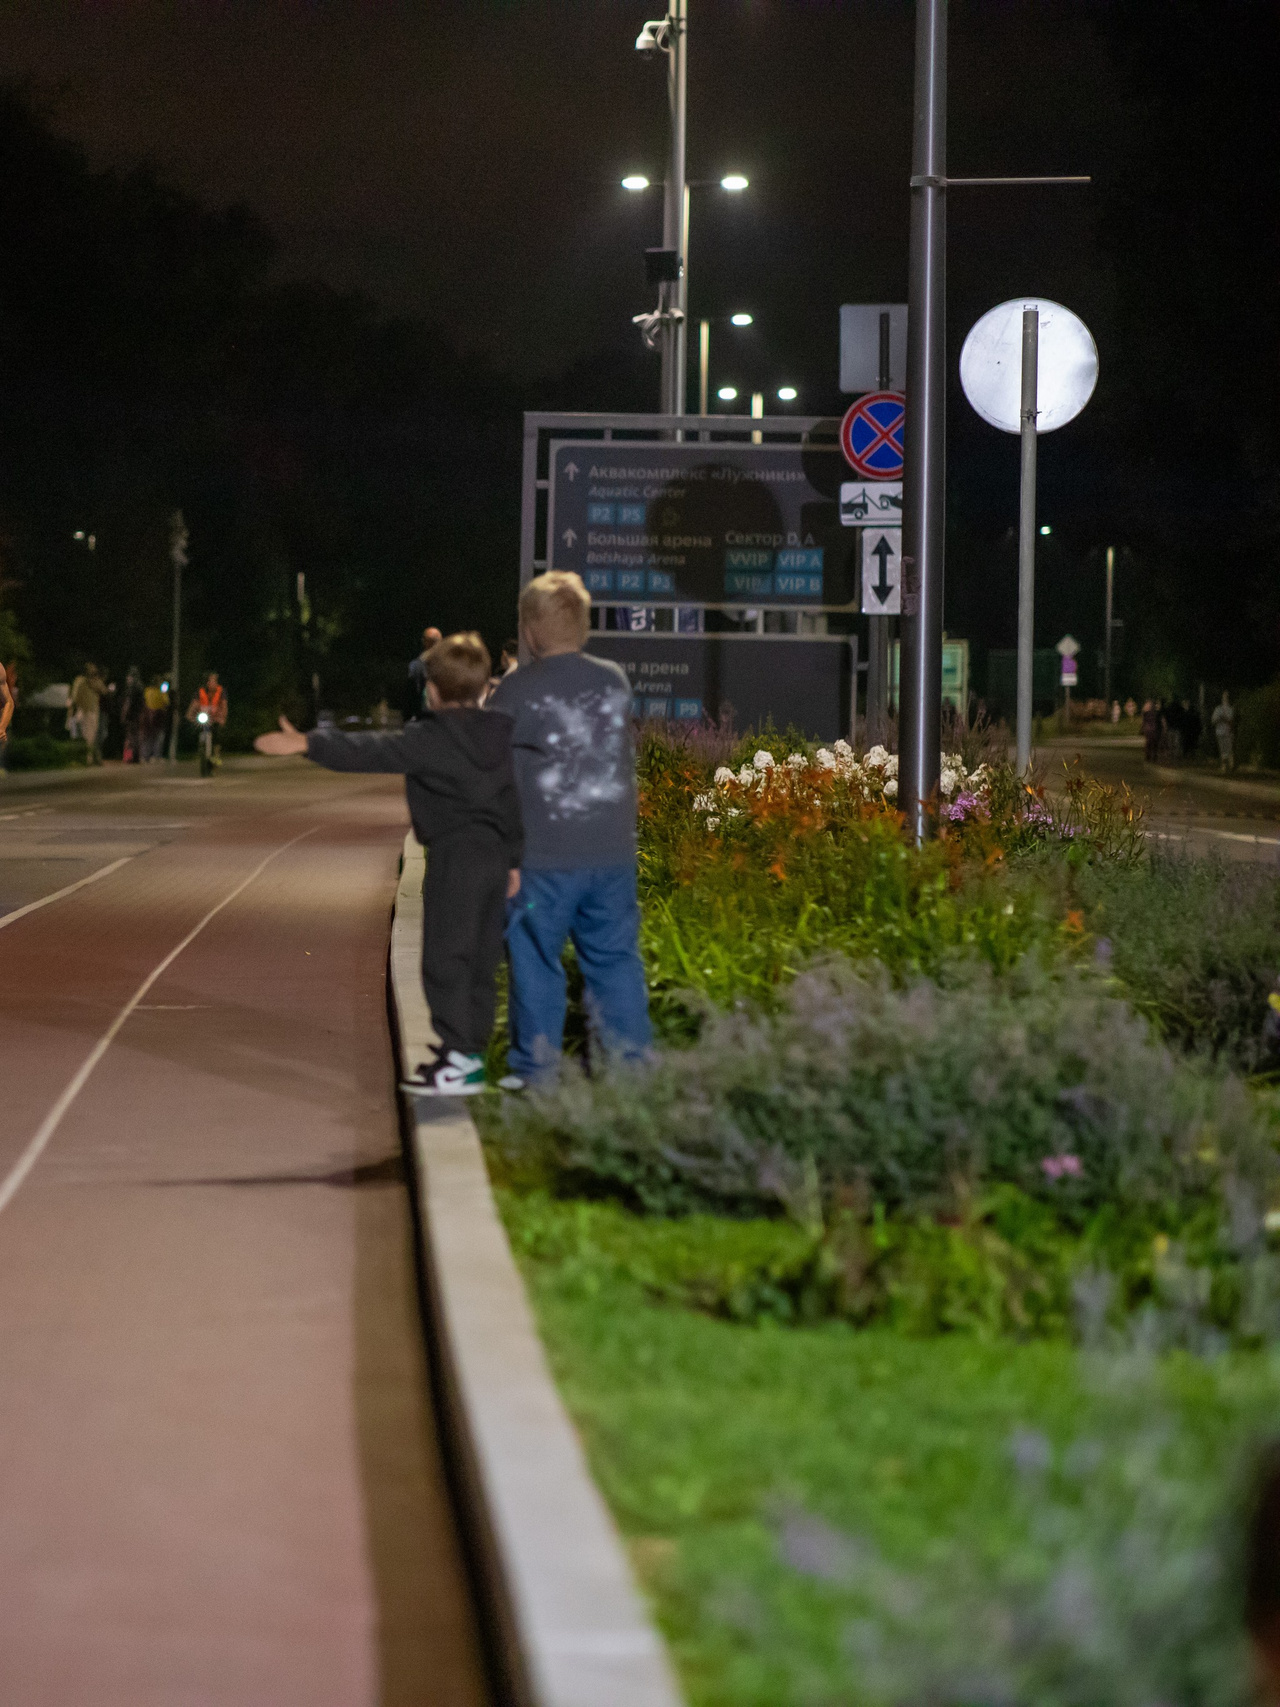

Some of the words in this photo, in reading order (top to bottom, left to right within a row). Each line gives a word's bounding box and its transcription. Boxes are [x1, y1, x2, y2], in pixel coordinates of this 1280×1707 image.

[588, 464, 706, 480] Аквакомплекс
[711, 467, 806, 484] «Лужники»
[588, 486, 639, 499] Aquatic
[592, 508, 610, 521] P2
[587, 531, 660, 547] Большая
[662, 534, 712, 549] арена
[725, 531, 783, 549] Сектор
[647, 553, 686, 565] Arena
[779, 553, 806, 566] VIP
[809, 553, 821, 567] A
[589, 574, 608, 587] P1
[621, 574, 639, 587] P2
[734, 576, 761, 589] VIP
[779, 577, 806, 590] VIP
[809, 577, 821, 590] B
[640, 662, 690, 677] арена
[634, 680, 672, 693] Arena
[680, 702, 698, 716] P9
